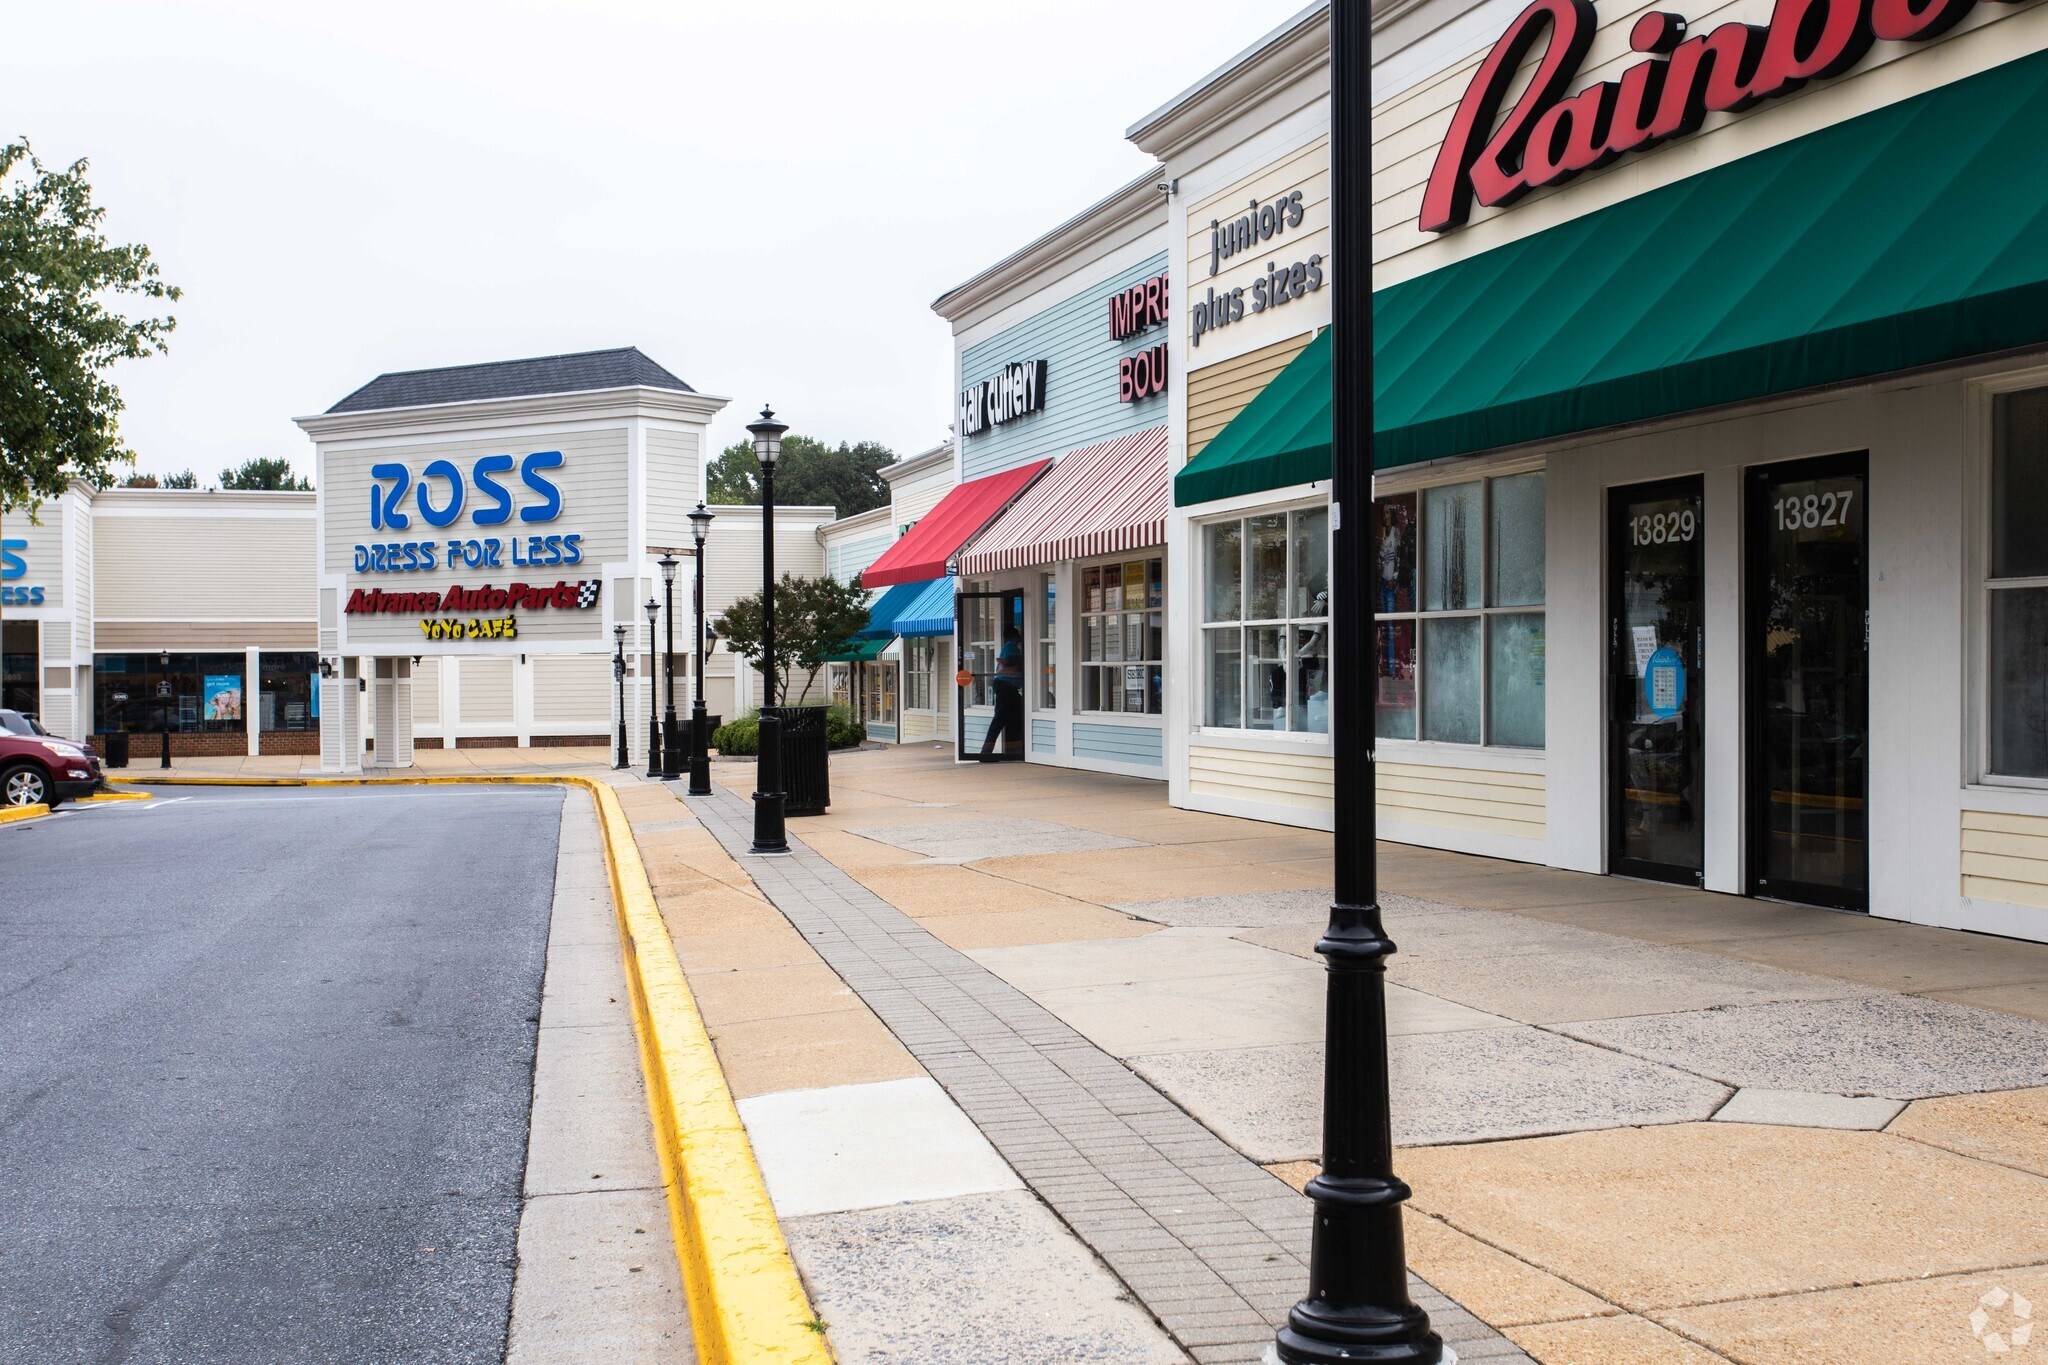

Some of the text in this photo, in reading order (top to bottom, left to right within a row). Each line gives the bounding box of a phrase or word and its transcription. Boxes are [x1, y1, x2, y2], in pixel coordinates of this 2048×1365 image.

[1419, 0, 1985, 233] Rainb
[1209, 190, 1304, 276] juniors
[1192, 253, 1323, 347] plus sizes
[1120, 343, 1168, 403] BOU
[960, 381, 984, 436] Hair
[371, 450, 566, 530] ROSS
[1774, 490, 1853, 531] 13827
[354, 534, 585, 572] DRESS FOR LESS
[1629, 510, 1695, 546] 13829
[344, 587, 441, 614] Advance
[466, 614, 518, 639] CAFÉ
